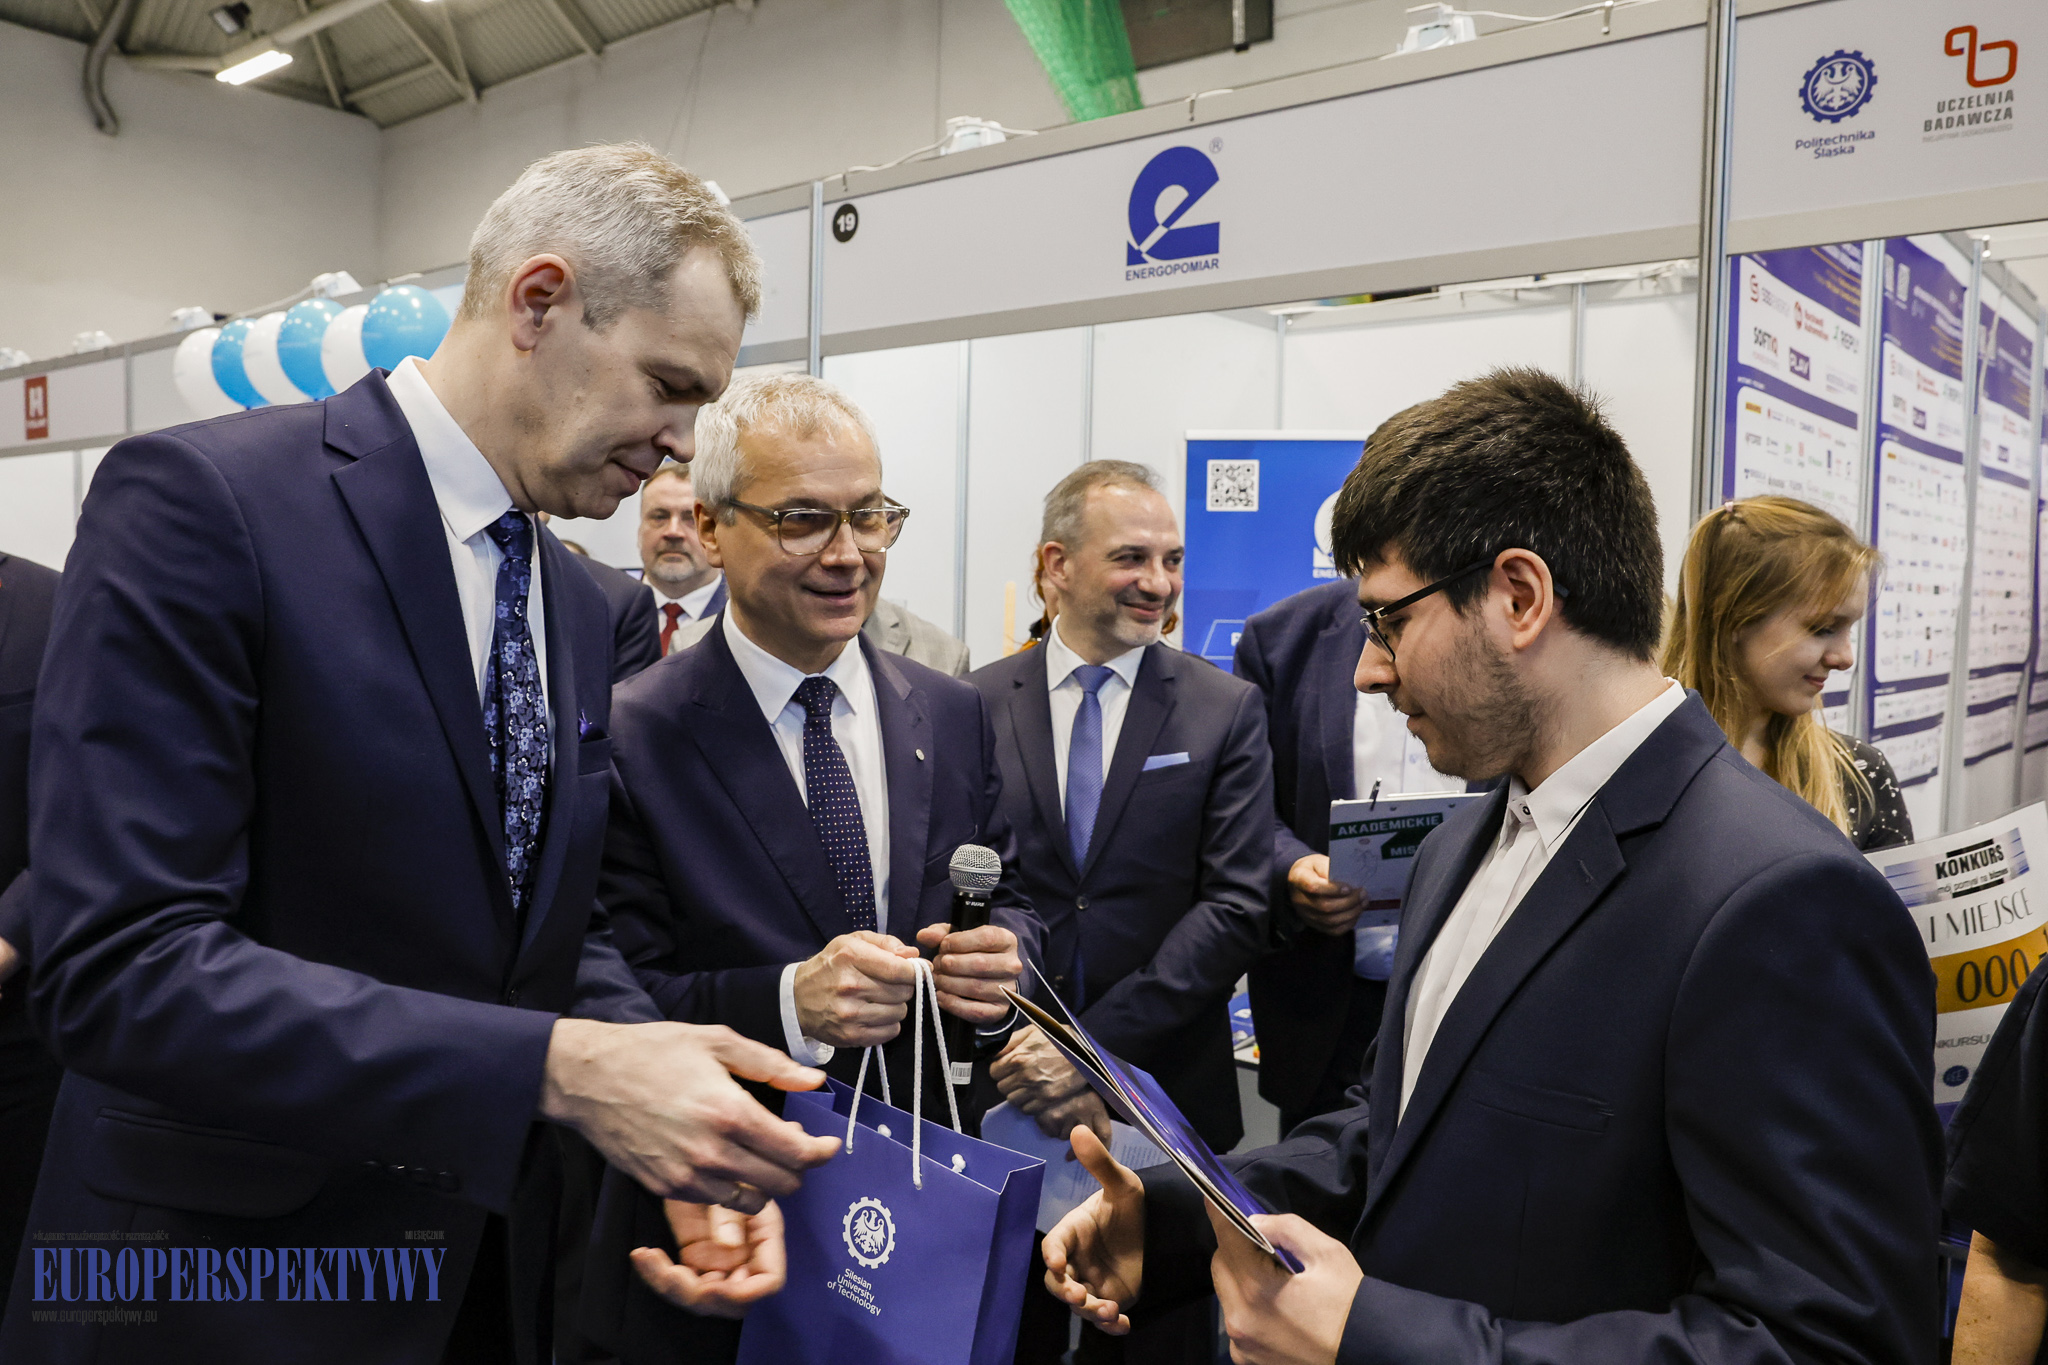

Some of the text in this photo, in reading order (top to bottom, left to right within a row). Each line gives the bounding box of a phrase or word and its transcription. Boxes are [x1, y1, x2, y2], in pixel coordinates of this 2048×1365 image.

[1936, 89, 2015, 114] UCZELNIA
[1923, 106, 2014, 133] BADAWCZA
[1795, 130, 1876, 151] Politechnika
[1813, 144, 1855, 160] Śląska
[836, 212, 856, 233] 19
[1125, 258, 1220, 282] ENERGOPOMIAR
[1337, 814, 1440, 836] AKADEMICKIE
[1390, 844, 1420, 857] MIS
[1935, 844, 2005, 880] KONKURS
[1945, 887, 2033, 940] MIEJSCE
[837, 1274, 875, 1303] University
[844, 1268, 872, 1290] Silesian
[827, 1280, 882, 1317] of Technology
